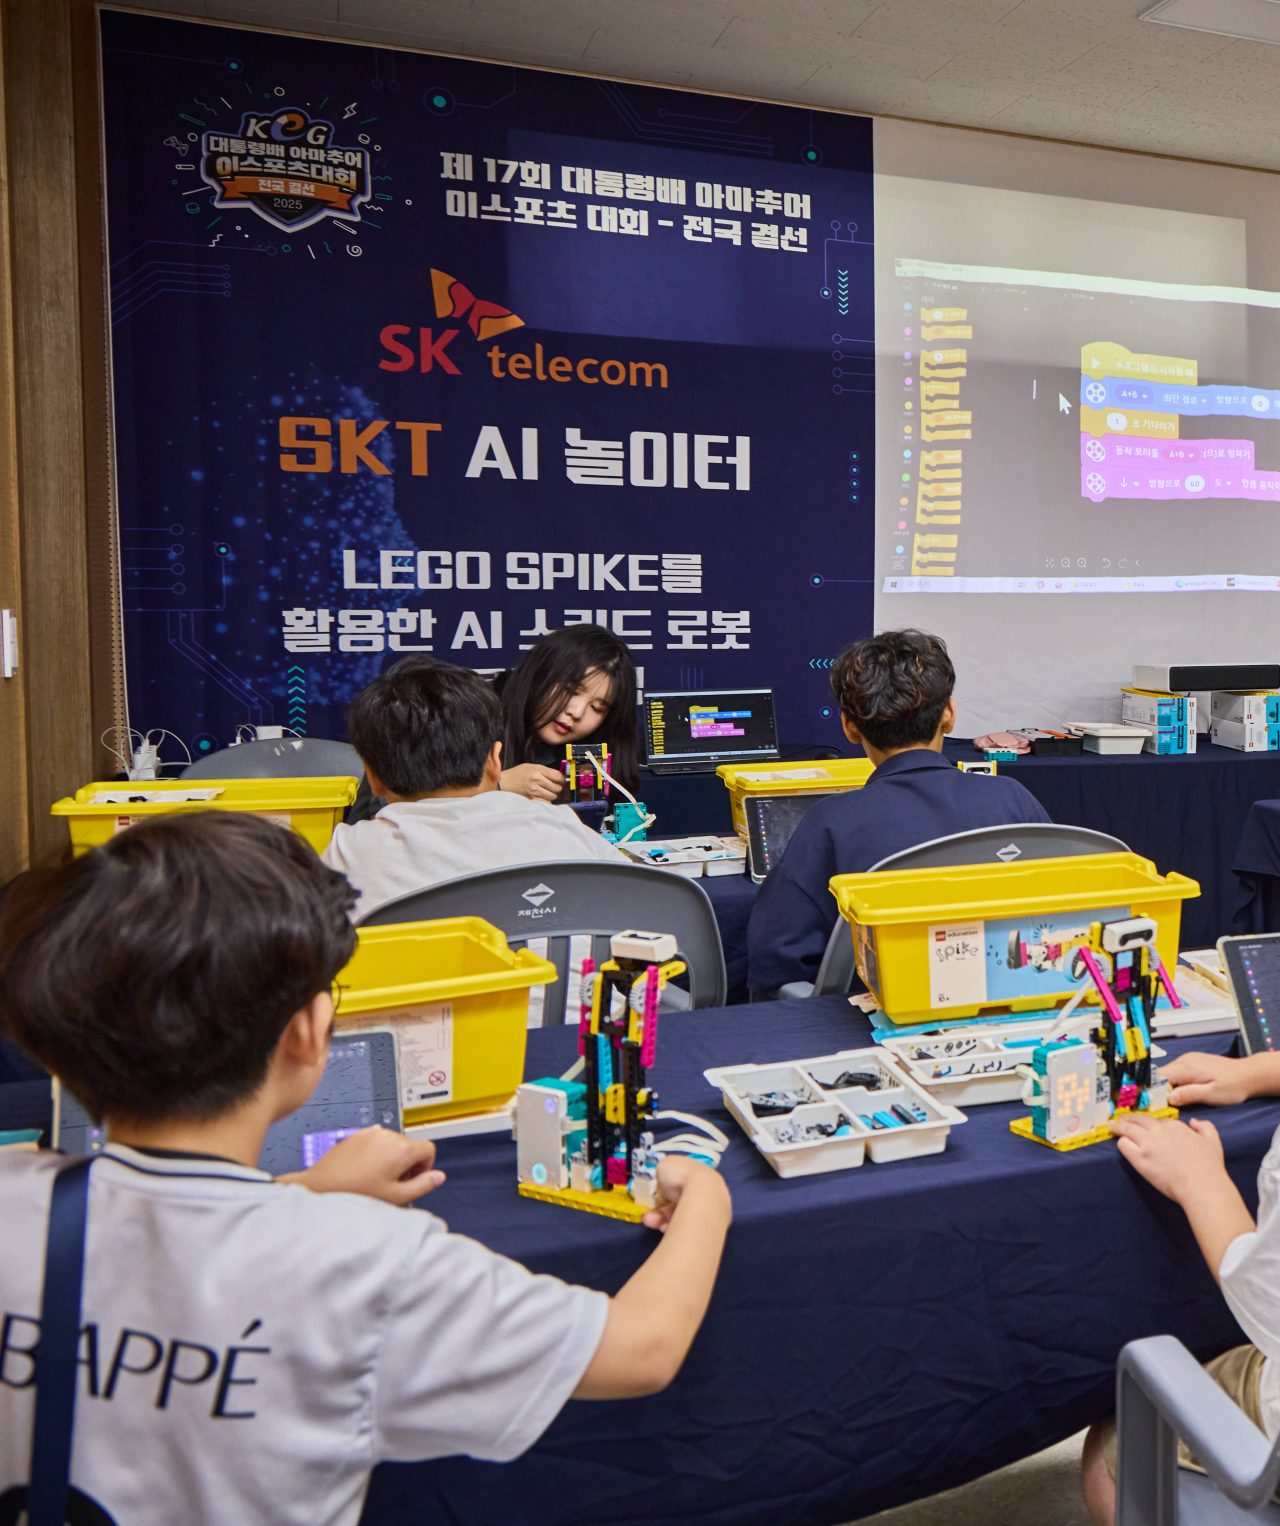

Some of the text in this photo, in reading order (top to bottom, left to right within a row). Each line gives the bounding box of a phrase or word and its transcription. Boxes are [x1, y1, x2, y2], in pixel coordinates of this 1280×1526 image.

[209, 136, 362, 169] 대통령배 아마추어
[216, 156, 357, 190] 이스포츠대회
[258, 179, 315, 197] 전국 결선
[439, 151, 812, 219] 제 17회 대통령배 아마추어
[273, 197, 303, 210] 2025
[446, 189, 578, 229] 이스포츠
[586, 204, 649, 236] 대회
[683, 215, 743, 246] 전국
[751, 221, 808, 253] 결선
[378, 324, 669, 388] SK telecom
[1121, 390, 1138, 399] A+B
[1142, 420, 1175, 431] 기다리기
[278, 416, 751, 491] SKT AI 놀이터
[1135, 447, 1159, 459] 모터를
[342, 549, 703, 594] LEGO SPIKE를
[282, 607, 437, 653] 활용한
[450, 610, 503, 650] AI
[666, 610, 751, 650] 로봇
[517, 906, 557, 919] 제천시
